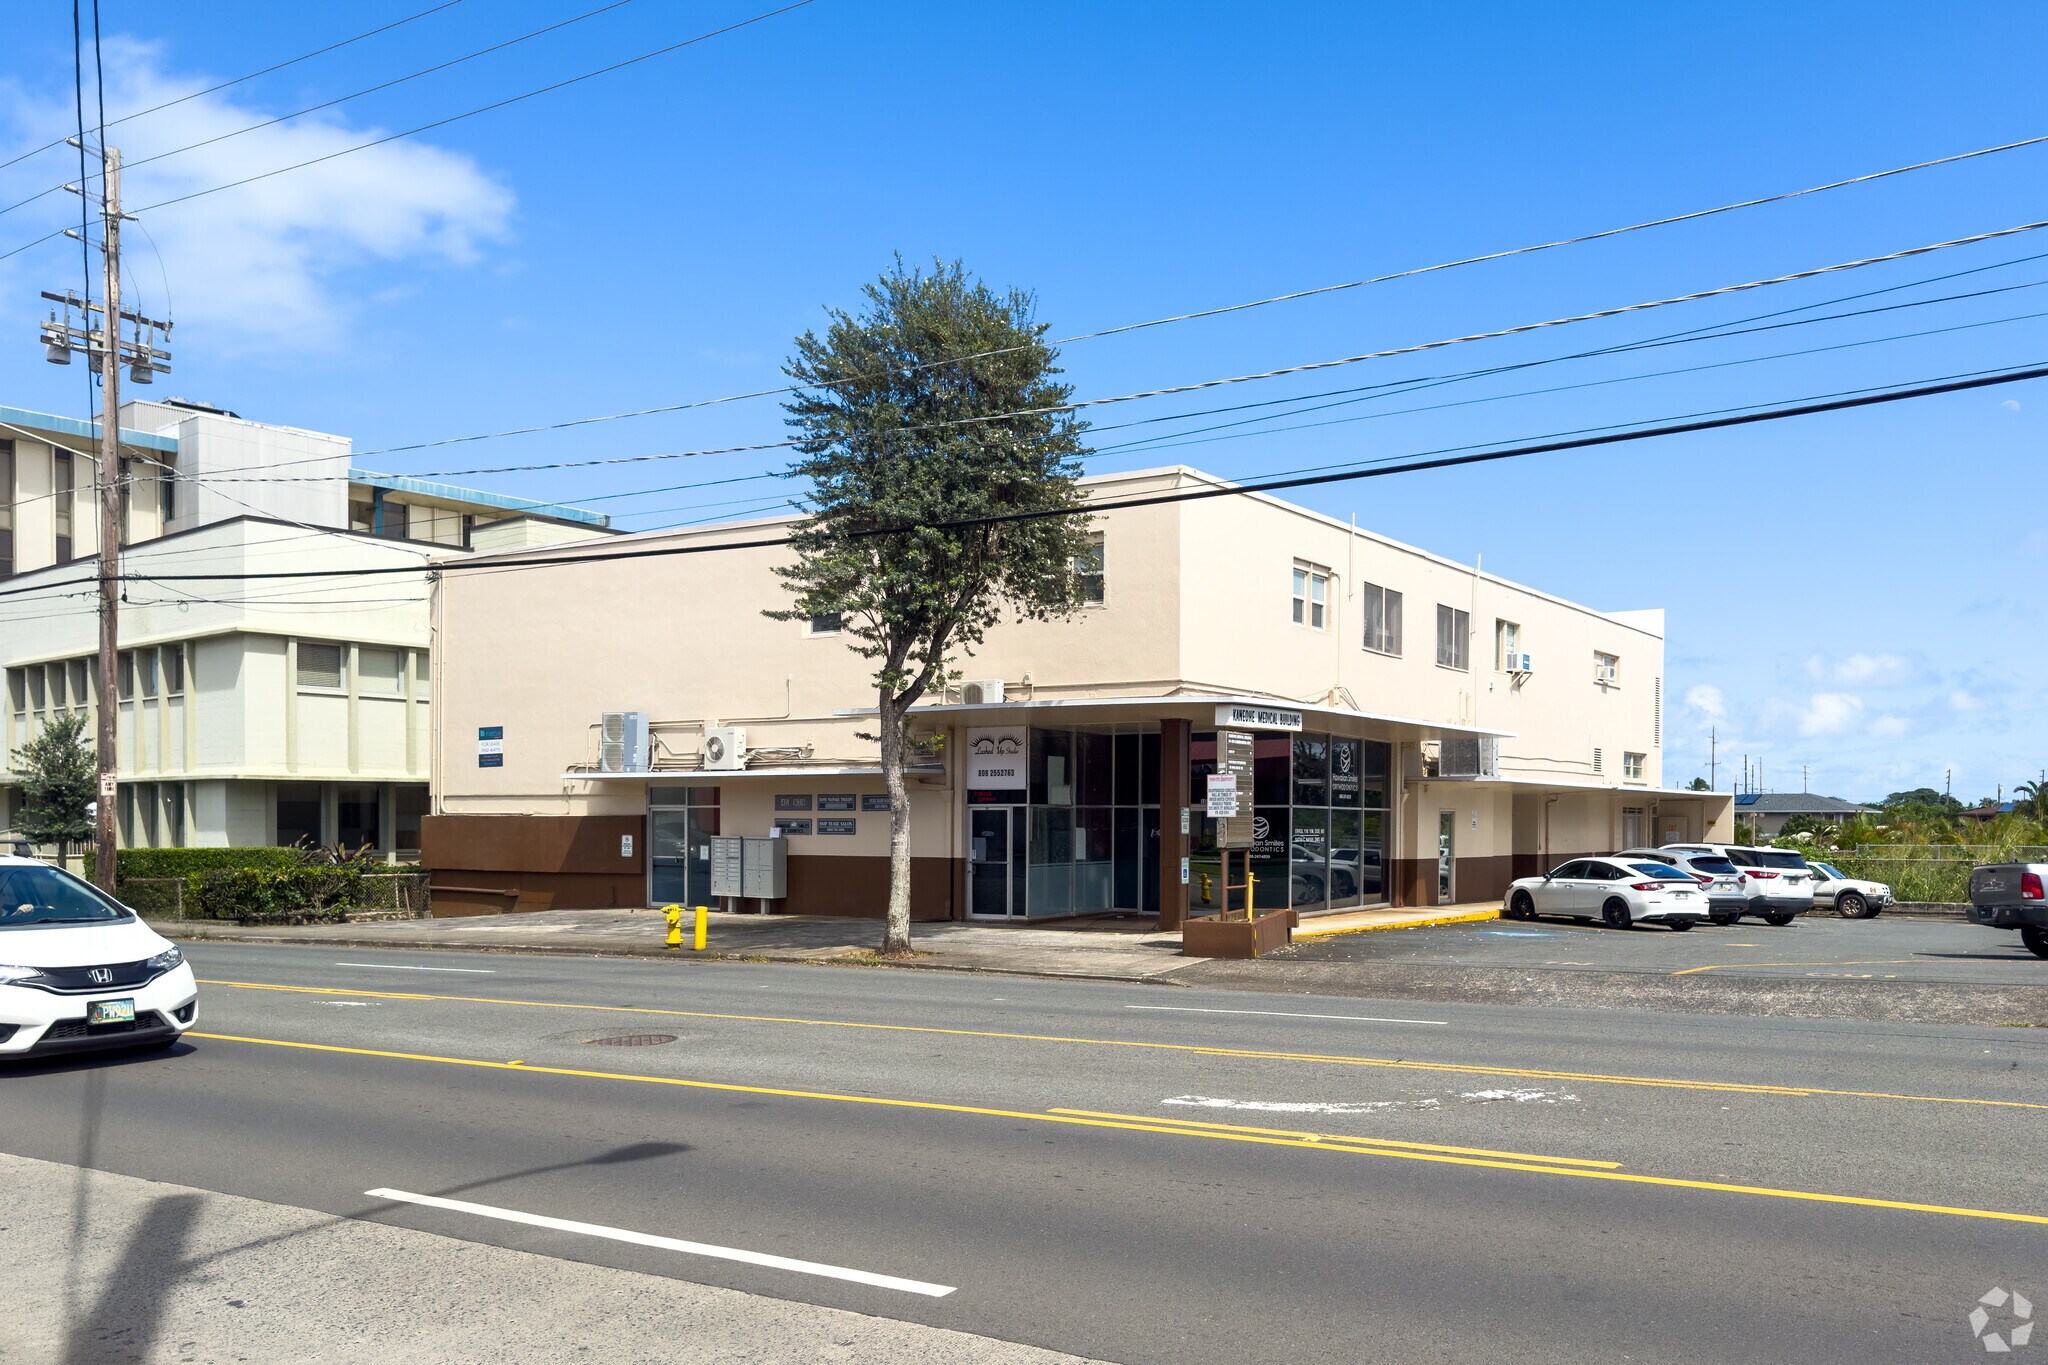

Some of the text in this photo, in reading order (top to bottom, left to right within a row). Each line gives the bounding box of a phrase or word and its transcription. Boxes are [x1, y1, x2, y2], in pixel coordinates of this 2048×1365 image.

[1232, 709, 1300, 727] KANEOHE MEDICAL BUILDING
[975, 745, 994, 755] Lashed
[996, 745, 1005, 756] Up
[978, 769, 1015, 777] 808 2552763
